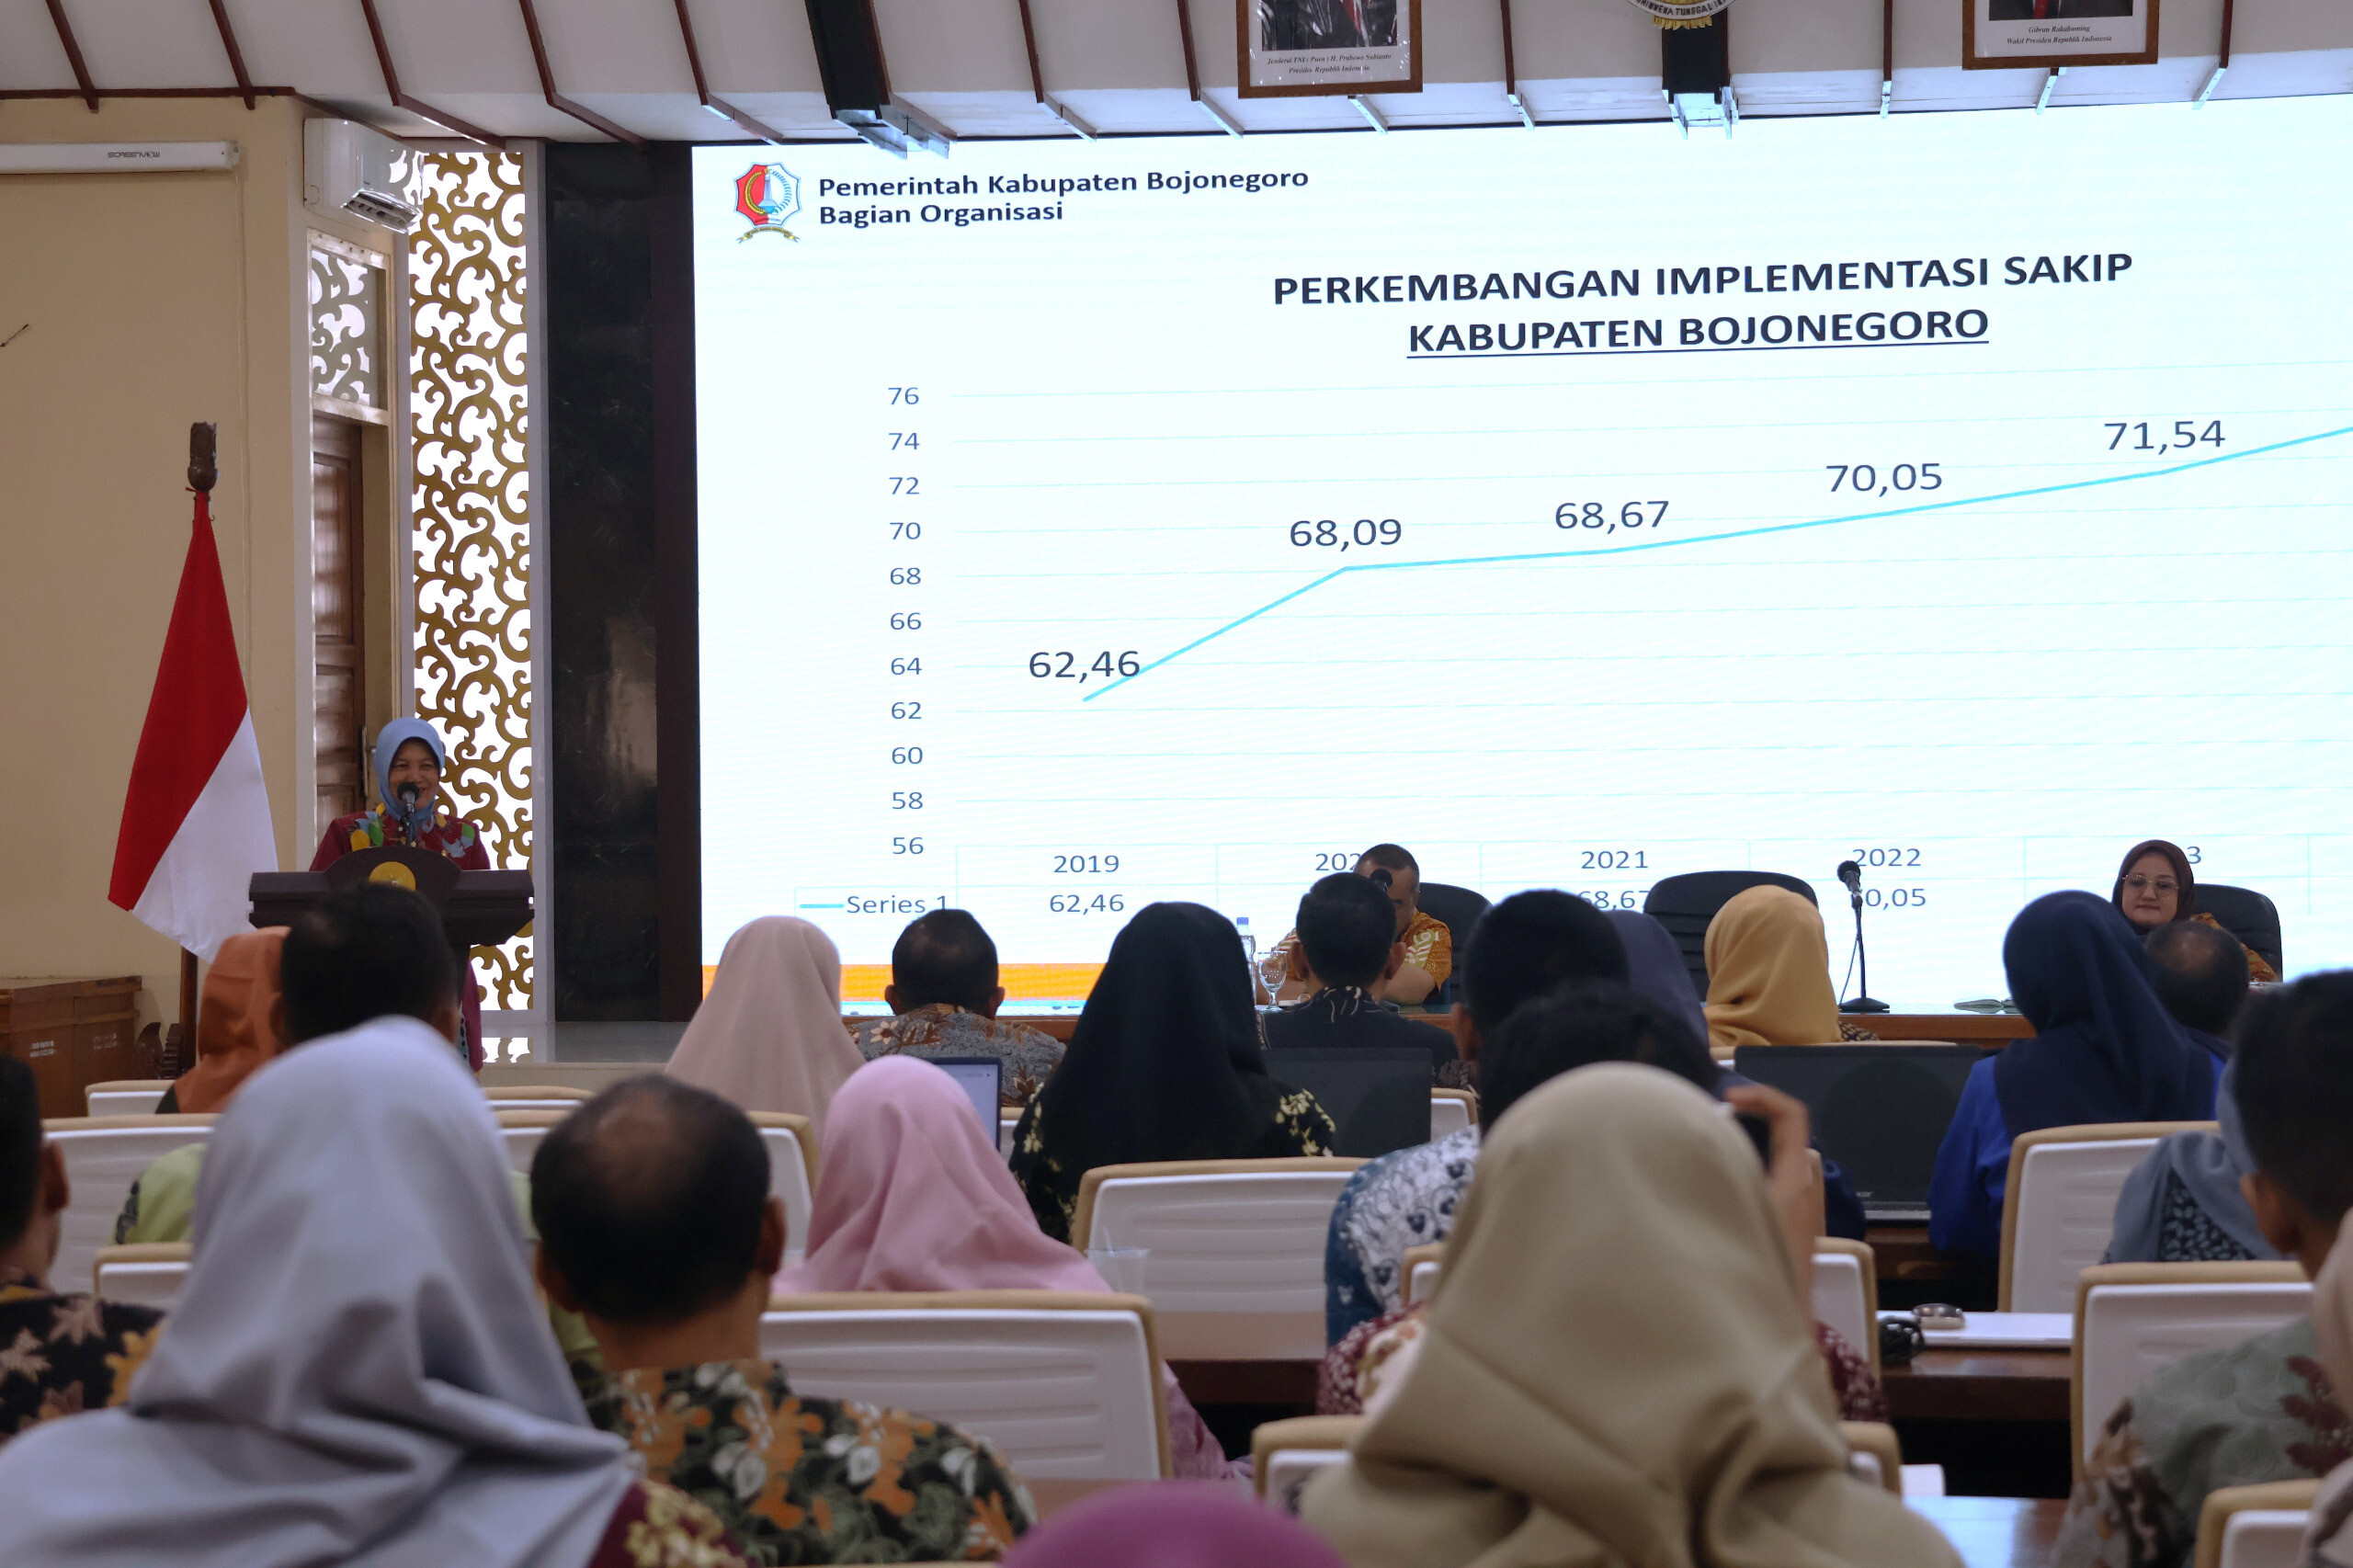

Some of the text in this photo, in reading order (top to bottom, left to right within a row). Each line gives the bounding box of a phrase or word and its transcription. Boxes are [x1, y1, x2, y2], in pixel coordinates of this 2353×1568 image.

[1676, 5, 1712, 16] TUNGGAL
[2052, 36, 2080, 44] Republik
[820, 170, 1309, 199] Pemerintah Kabupaten Bojonegoro
[820, 201, 1063, 230] Bagian Organisasi
[1275, 253, 2132, 305] PERKEMBANGAN IMPLEMENTASI SAKIP
[1410, 309, 1989, 352] KABUPATEN BOJONEGORO
[889, 388, 918, 404] 76
[889, 433, 919, 449] 74
[2104, 420, 2225, 455] 71,54
[890, 477, 919, 494] 72
[1826, 463, 1941, 497] 70,05
[1556, 501, 1668, 534] 68,67
[890, 523, 920, 540] 70
[1290, 519, 1401, 551] 68,09
[891, 568, 921, 585] 68
[891, 613, 921, 630] 66
[892, 658, 922, 675] 64
[1029, 651, 1140, 683] 62,46
[892, 702, 921, 719] 62
[892, 747, 923, 764] 60
[892, 792, 923, 809] 58
[893, 837, 923, 854] 56
[1054, 848, 1921, 872] 2019 202 2021 2022
[847, 895, 926, 914] Series
[1050, 894, 1124, 915] 62,46
[1859, 888, 1927, 910] 0,05
